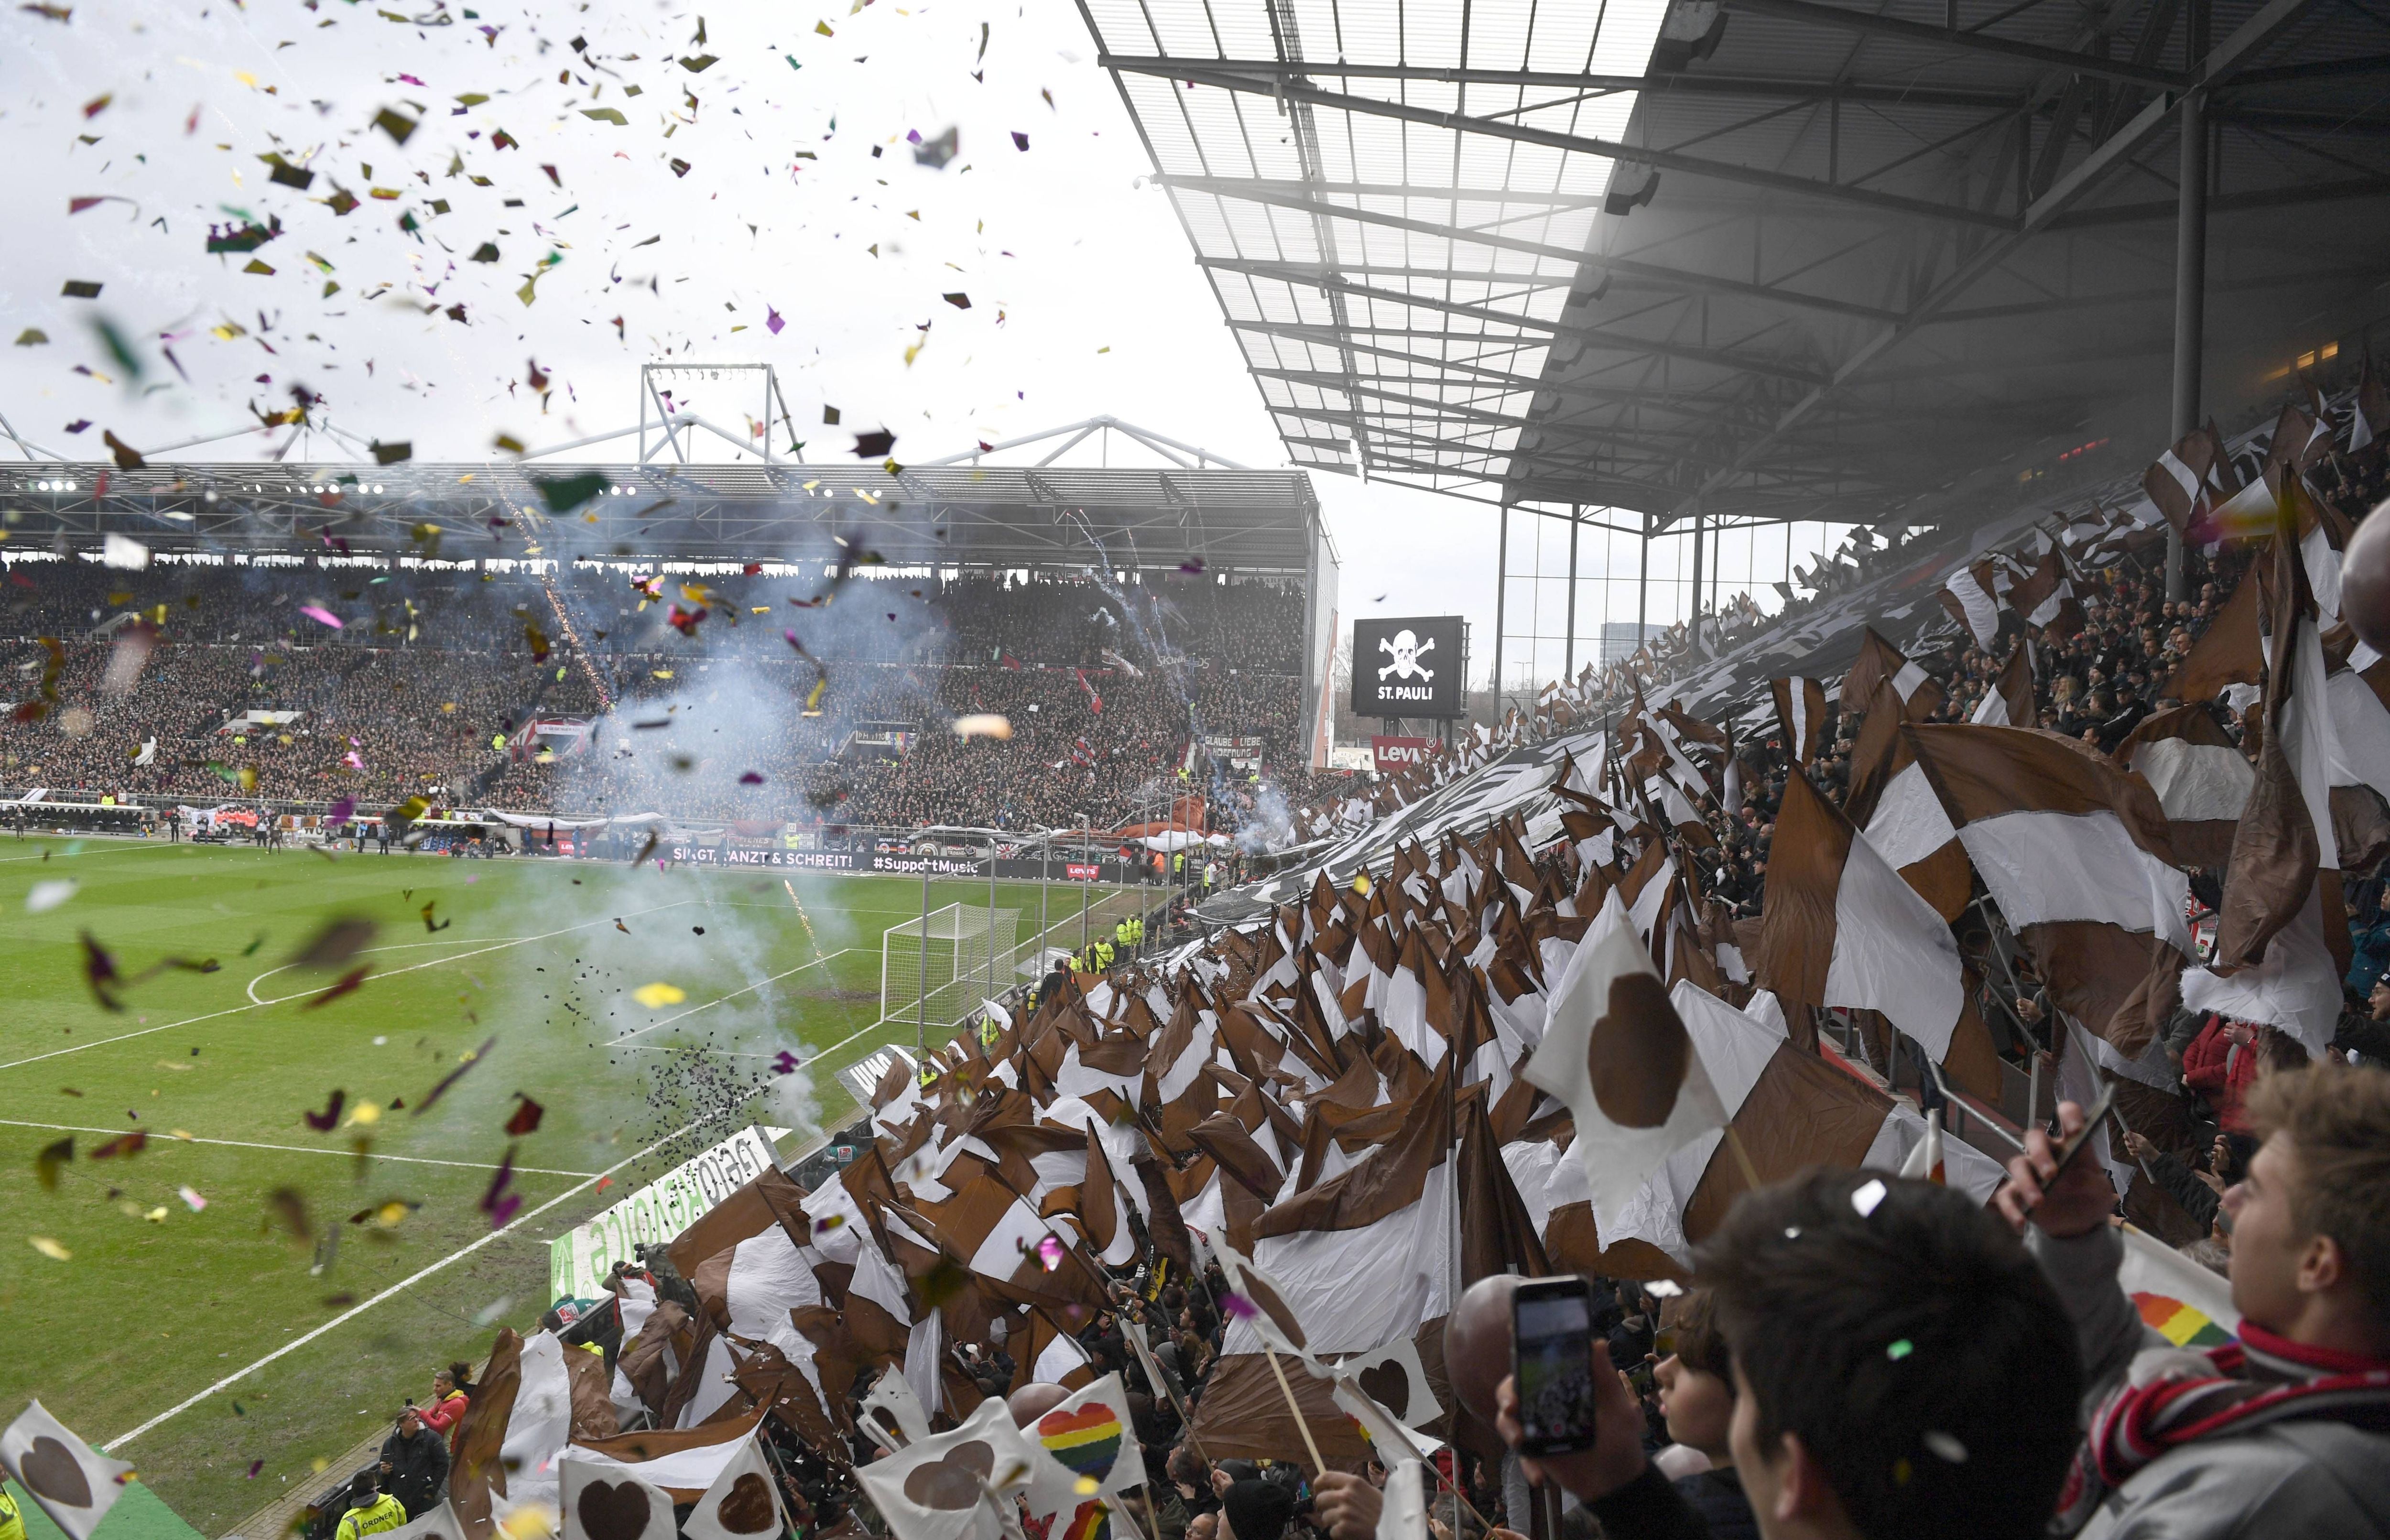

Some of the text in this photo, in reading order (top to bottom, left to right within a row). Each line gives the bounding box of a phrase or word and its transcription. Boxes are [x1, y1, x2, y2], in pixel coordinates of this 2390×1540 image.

[1378, 686, 1433, 700] ST. PAULI
[1205, 736, 1261, 747] GLAUBE LIEBE
[1213, 748, 1251, 757] HOFFNUNG
[725, 850, 769, 864] ANZT
[772, 853, 782, 864] &
[786, 853, 852, 868] SCHREIT!
[873, 857, 978, 874] #SupportMusic
[362, 1512, 393, 1529] ORDNER
